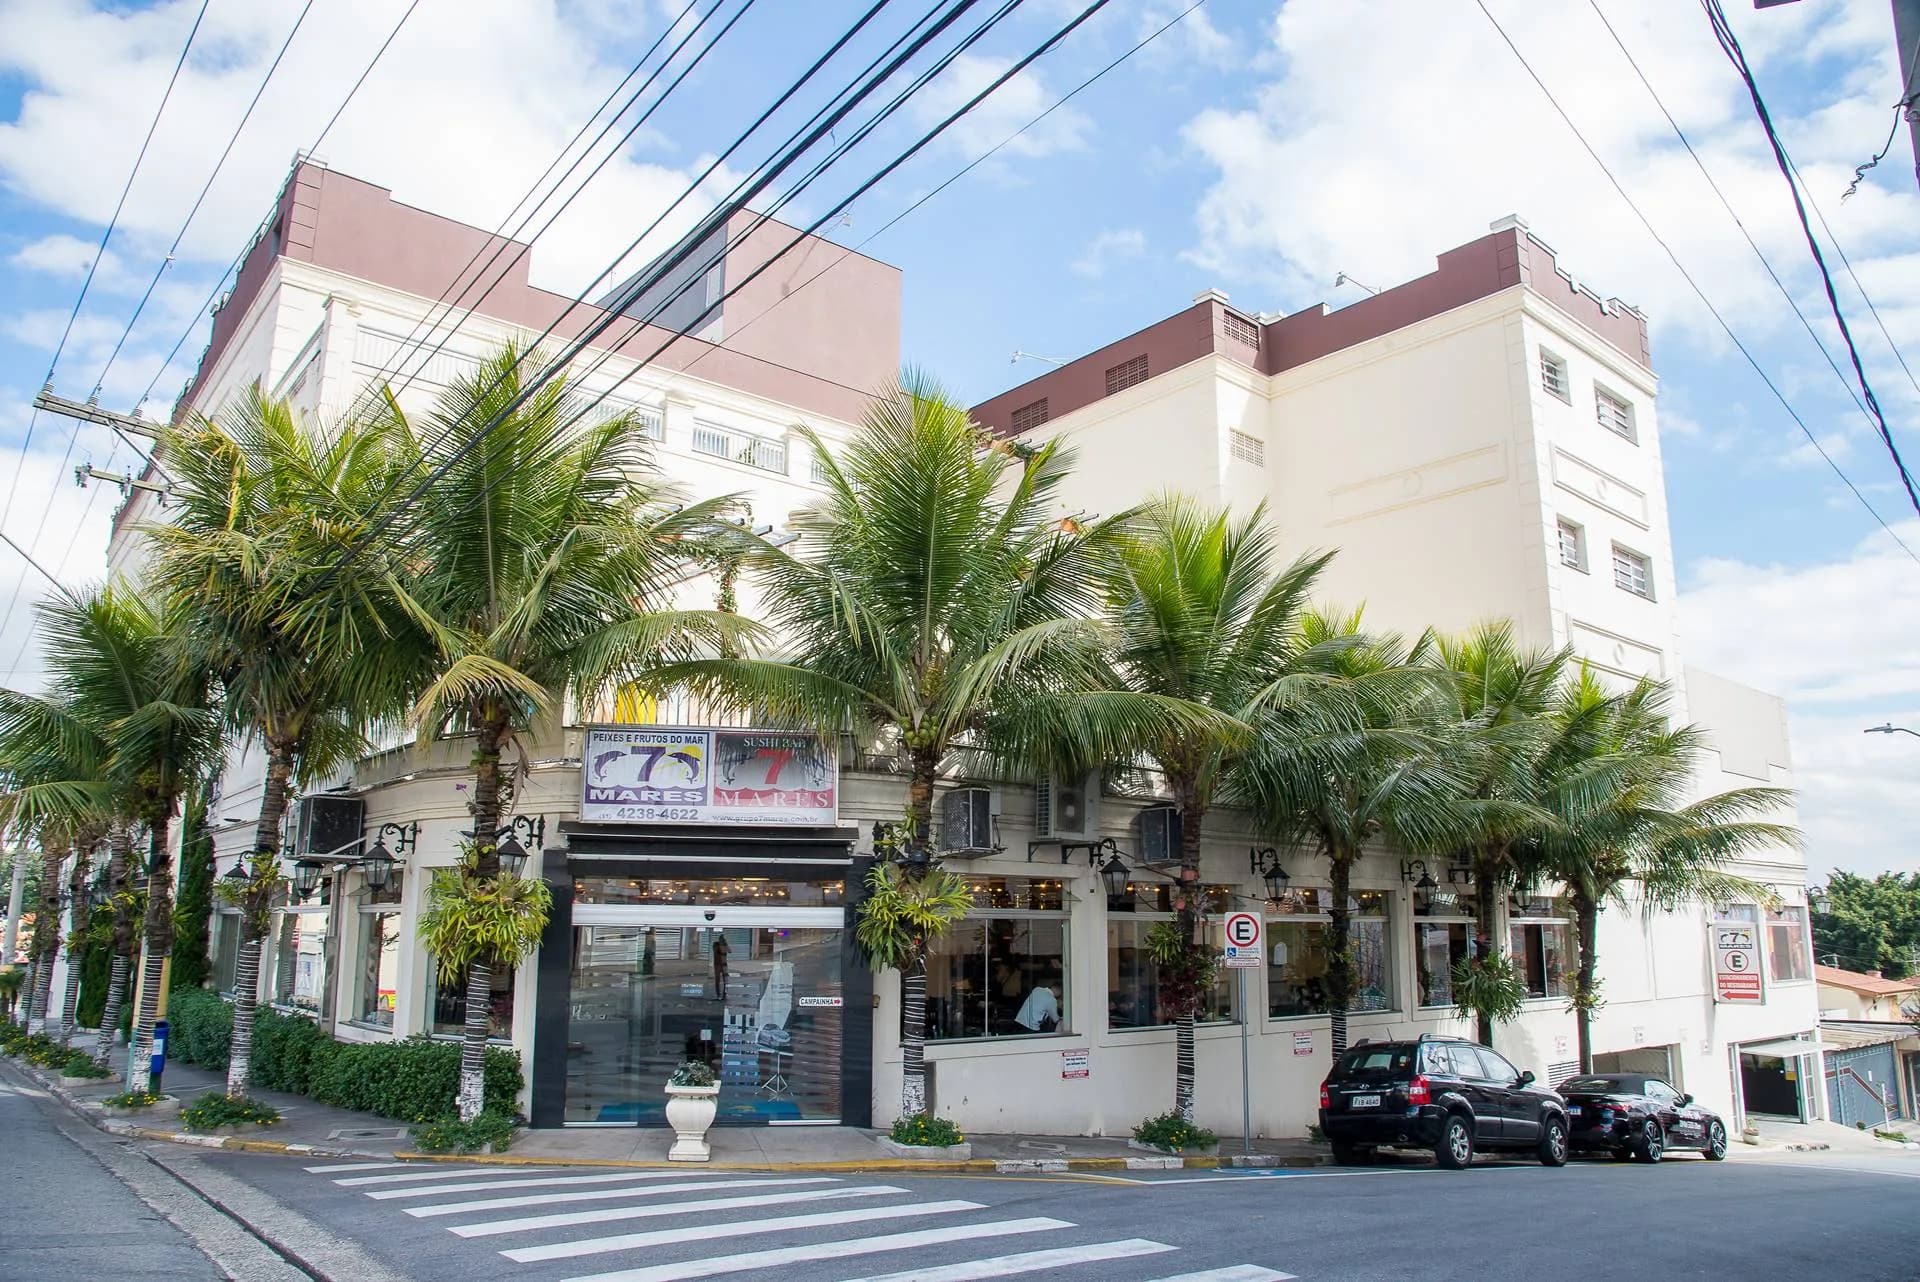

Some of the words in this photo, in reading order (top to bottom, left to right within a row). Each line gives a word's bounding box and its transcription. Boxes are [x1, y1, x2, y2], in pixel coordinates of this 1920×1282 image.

[593, 733, 624, 743] PEIXES
[626, 734, 631, 743] E
[634, 734, 668, 744] FRUTOS
[670, 735, 682, 744] DO
[684, 735, 704, 744] MAR
[743, 737, 778, 747] SUSHI
[630, 745, 667, 782] 7
[755, 748, 794, 784] 7
[589, 789, 704, 802] MARES
[719, 791, 829, 808] MARES
[616, 807, 699, 820] 4238-4622
[1236, 921, 1250, 940] E
[1729, 932, 1740, 943] 7
[1731, 955, 1742, 968] E
